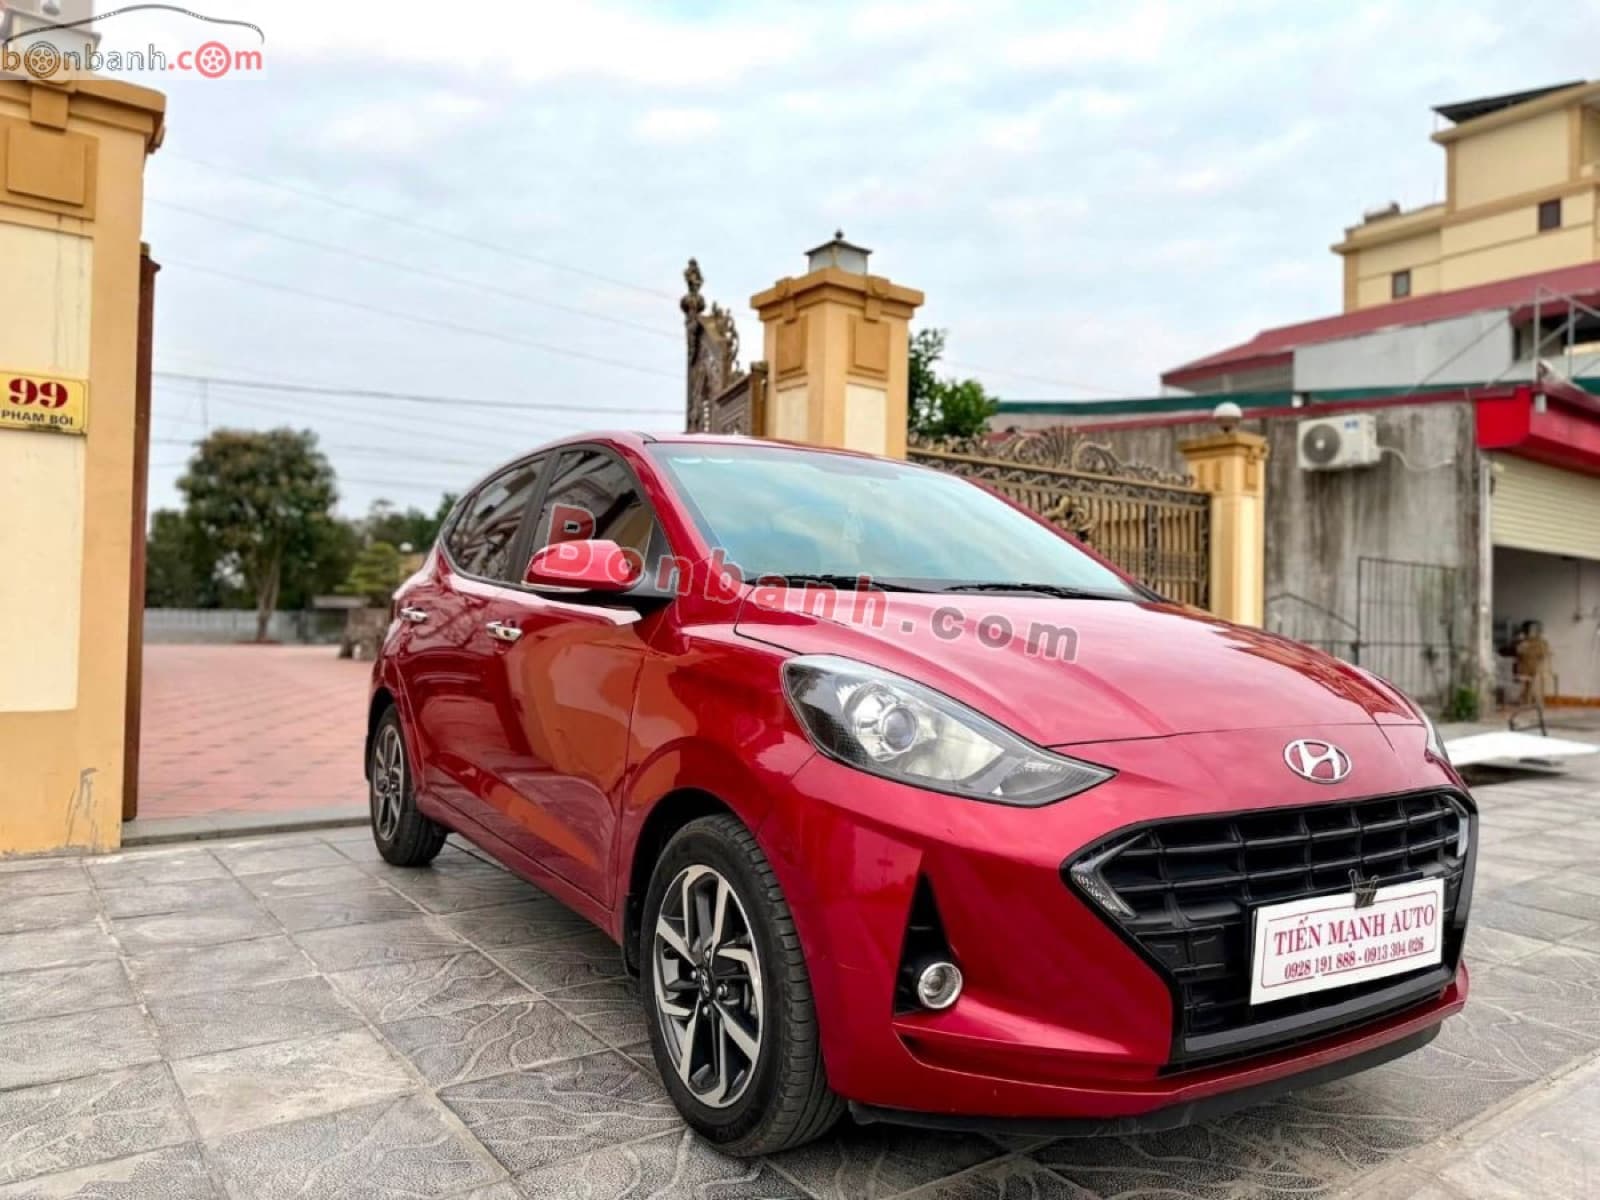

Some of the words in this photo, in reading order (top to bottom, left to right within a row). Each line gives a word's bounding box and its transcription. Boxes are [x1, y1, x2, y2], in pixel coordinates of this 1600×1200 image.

[9, 378, 68, 408] 99
[1274, 916, 1323, 955] TIẾN
[1328, 914, 1385, 948] MẠNH
[1391, 904, 1434, 933] AUTO
[1284, 960, 1311, 979] 0928
[1315, 956, 1332, 973] 191
[1336, 950, 1356, 969] 888
[1364, 944, 1388, 962] 0913
